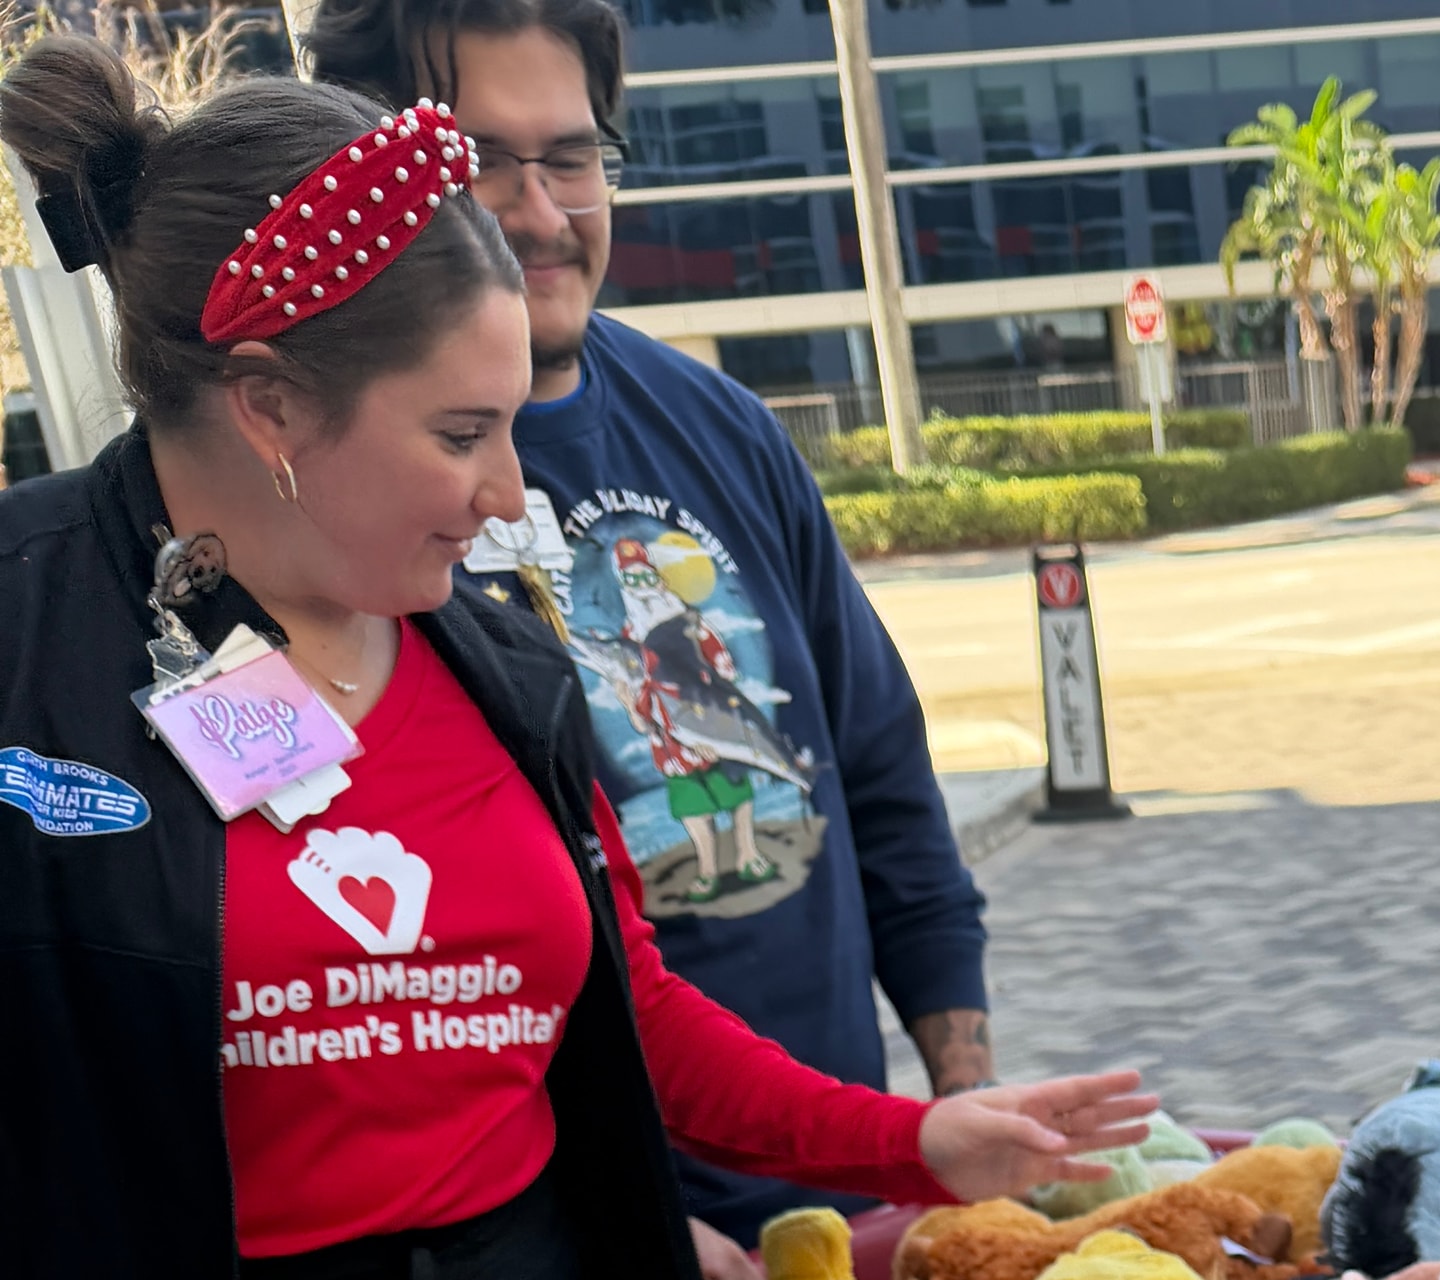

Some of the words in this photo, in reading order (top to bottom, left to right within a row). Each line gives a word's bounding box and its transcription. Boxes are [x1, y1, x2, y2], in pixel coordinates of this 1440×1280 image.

[563, 499, 603, 539] THE
[595, 487, 672, 521] LIDAY
[1046, 567, 1074, 600] V
[1051, 618, 1084, 776] VALET
[189, 693, 298, 760] Paige
[0, 764, 139, 816] EAMMATES
[53, 762, 110, 787] BROOKS
[36, 817, 94, 833] NDATION
[52, 805, 78, 820] KIDS
[226, 978, 314, 1022] Joe
[324, 954, 523, 1008] DiMaggio
[221, 1014, 403, 1068] ildren's
